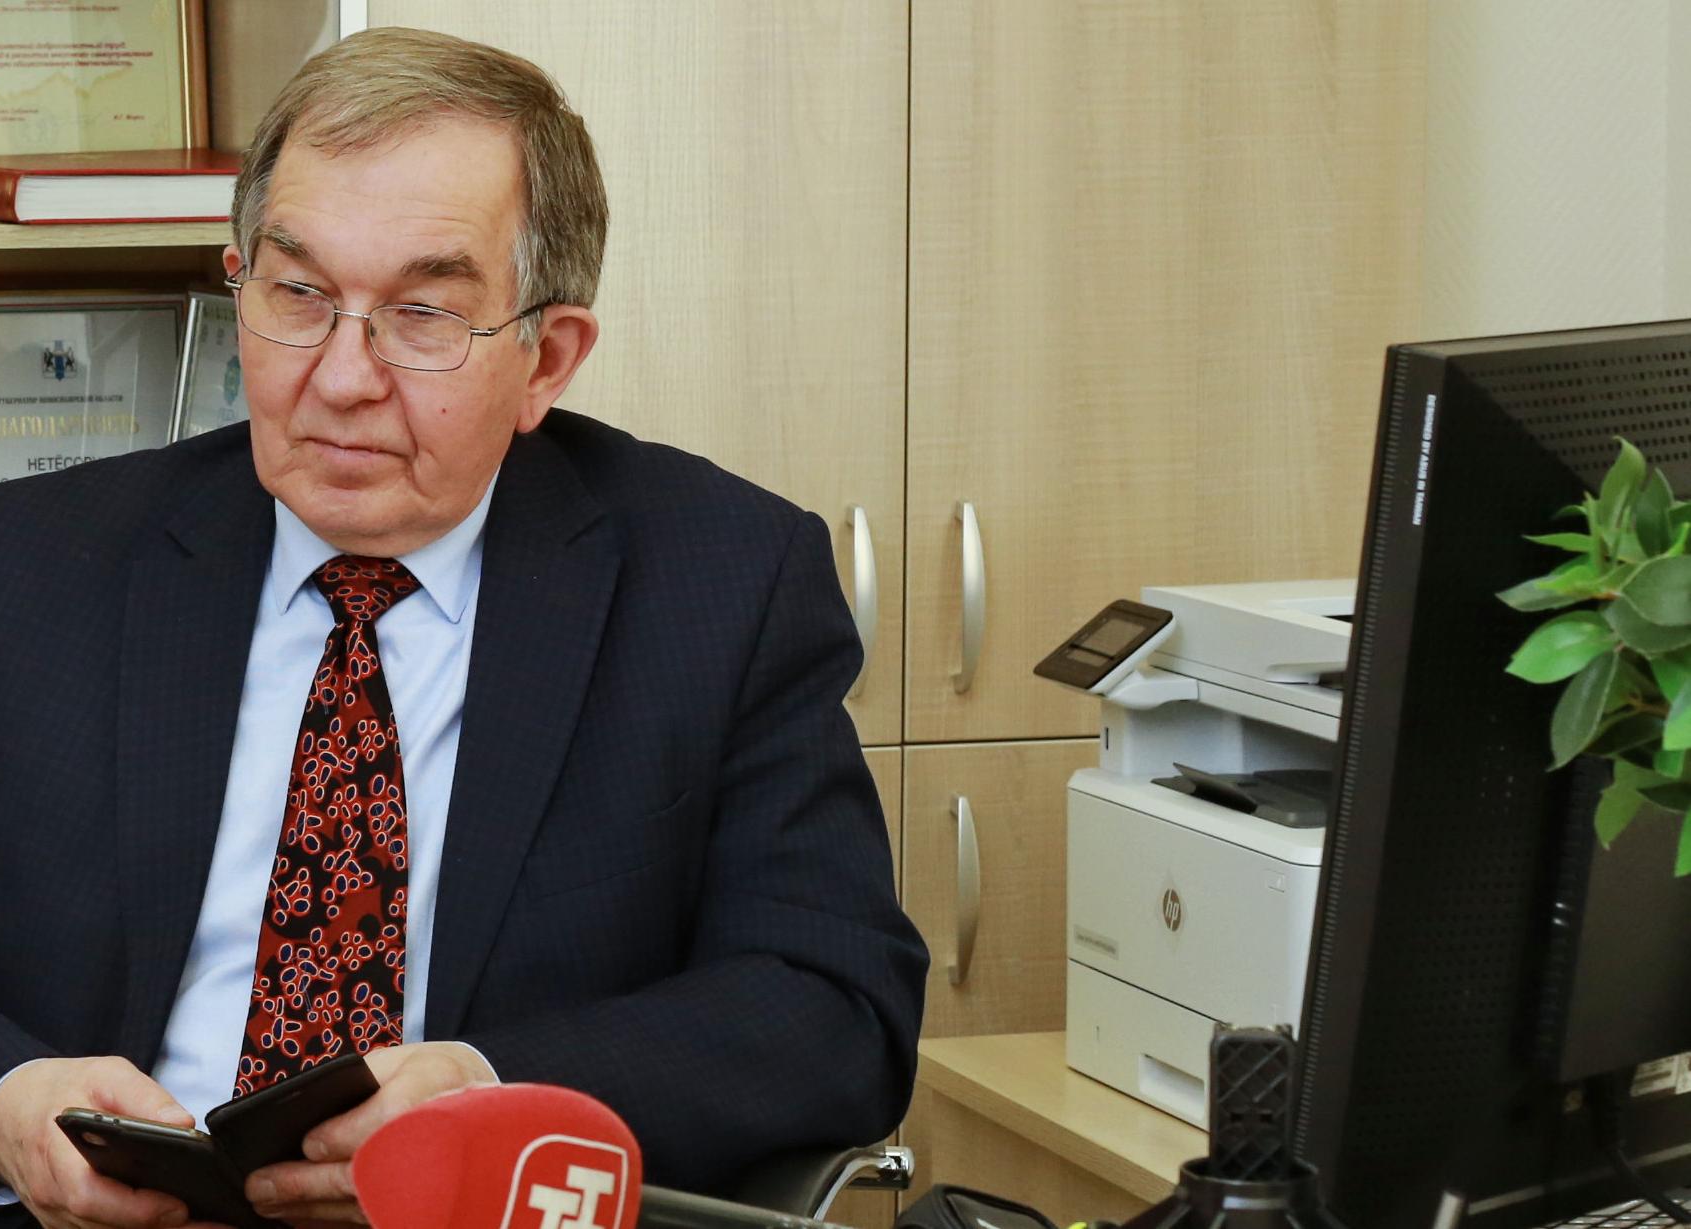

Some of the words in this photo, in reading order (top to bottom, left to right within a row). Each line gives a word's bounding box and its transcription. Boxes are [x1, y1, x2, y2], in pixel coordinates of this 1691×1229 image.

[1422, 394, 1437, 440] DESIGNED
[1421, 441, 1431, 455] BY
[1412, 491, 1425, 525] TAIWAN
[1165, 888, 1180, 932] hp
